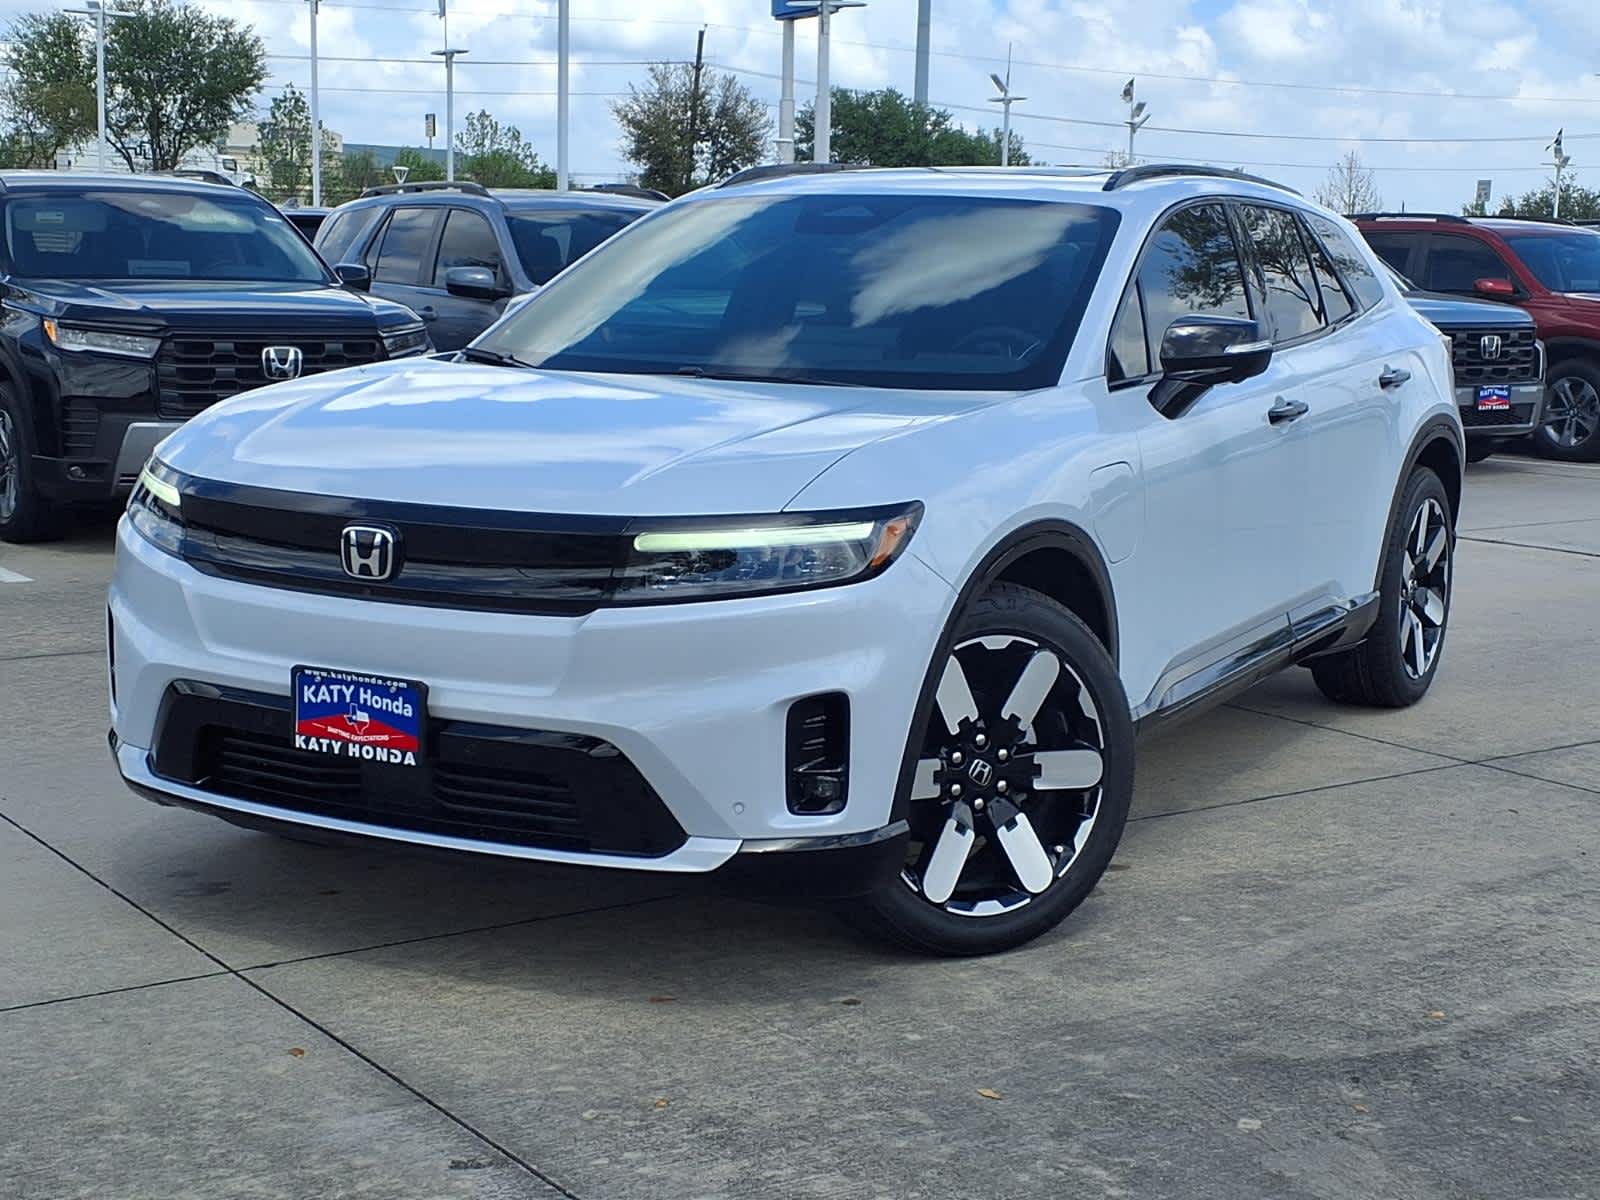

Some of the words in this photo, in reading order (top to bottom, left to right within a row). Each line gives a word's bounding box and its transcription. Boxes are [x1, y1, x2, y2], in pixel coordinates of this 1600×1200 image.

[304, 669, 407, 689] www.katyhonda.com
[303, 685, 354, 703] KATY
[359, 687, 413, 717] Honda
[295, 734, 342, 754] KATY
[348, 742, 416, 766] HONDA
